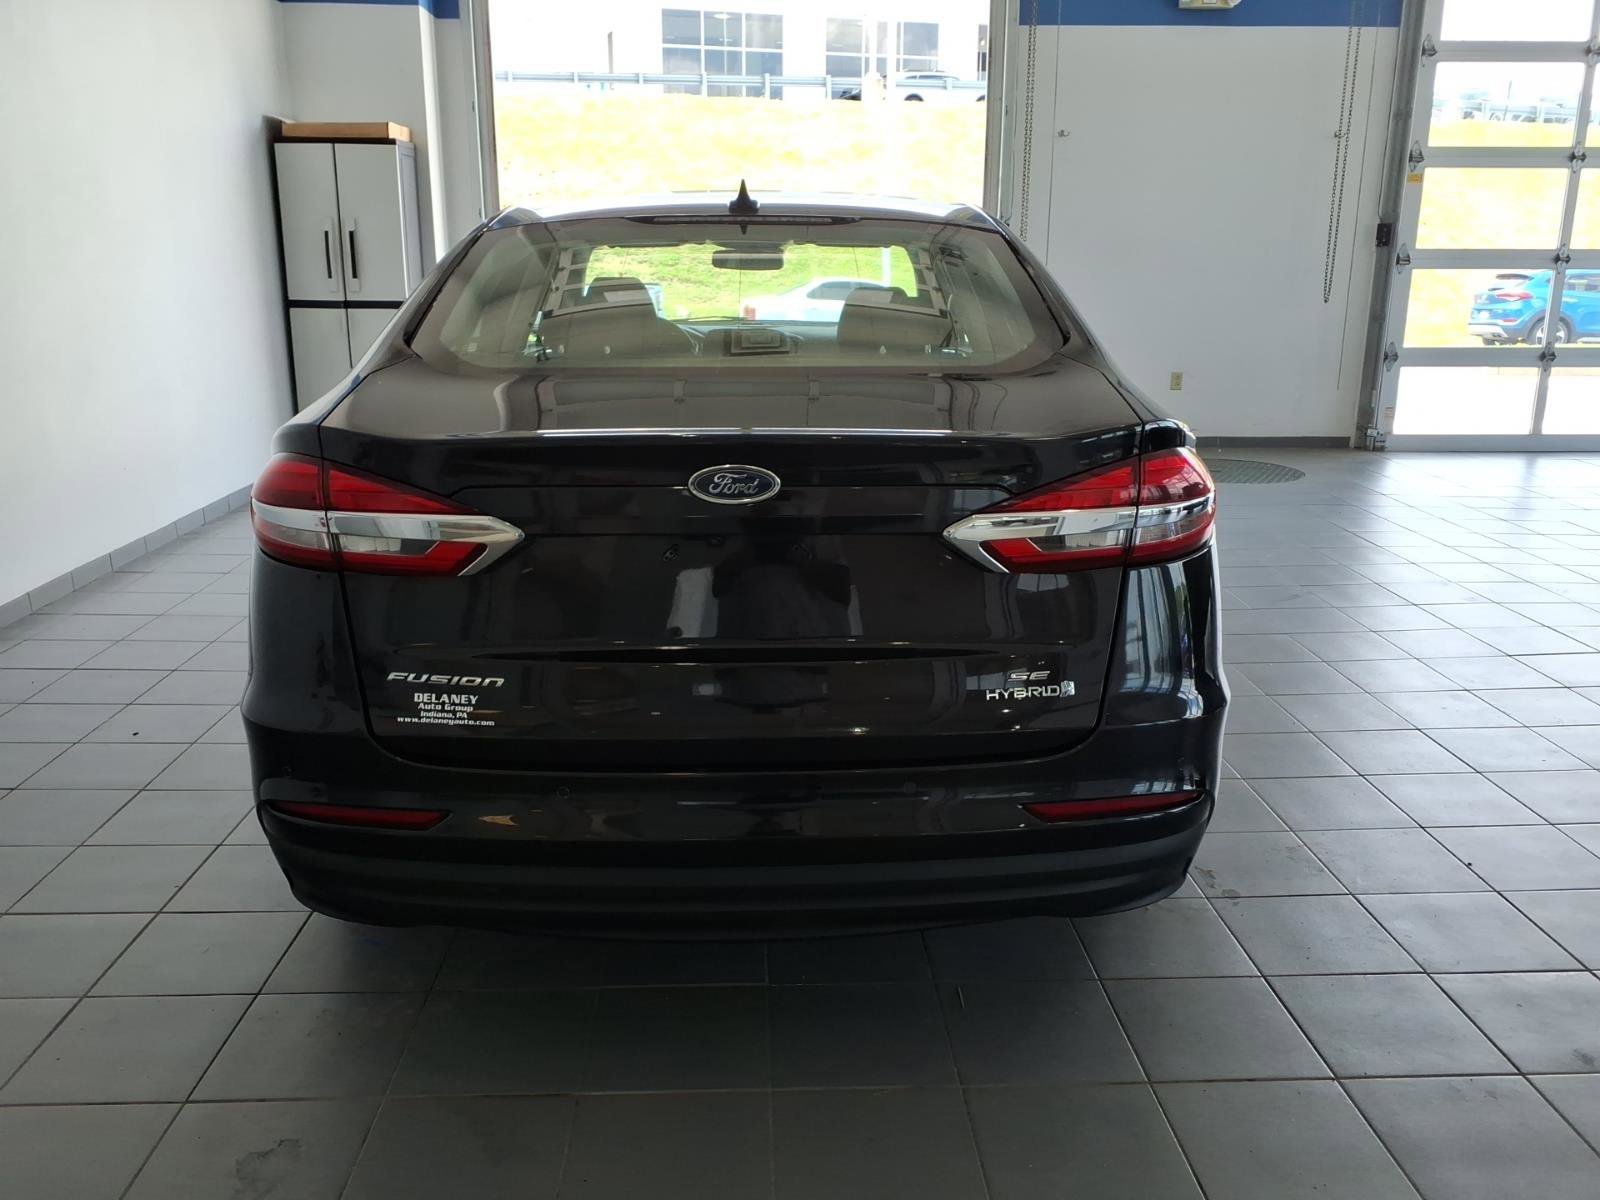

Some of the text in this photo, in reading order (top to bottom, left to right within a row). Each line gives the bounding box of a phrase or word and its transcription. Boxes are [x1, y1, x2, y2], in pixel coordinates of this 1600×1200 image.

[709, 472, 760, 494] Ford
[386, 672, 505, 687] FUSION
[1008, 671, 1050, 681] SE
[985, 685, 1060, 700] HYBRID
[414, 693, 479, 704] DELANEY
[444, 704, 474, 712] Group
[397, 717, 495, 726] www.delaneyauto.com
